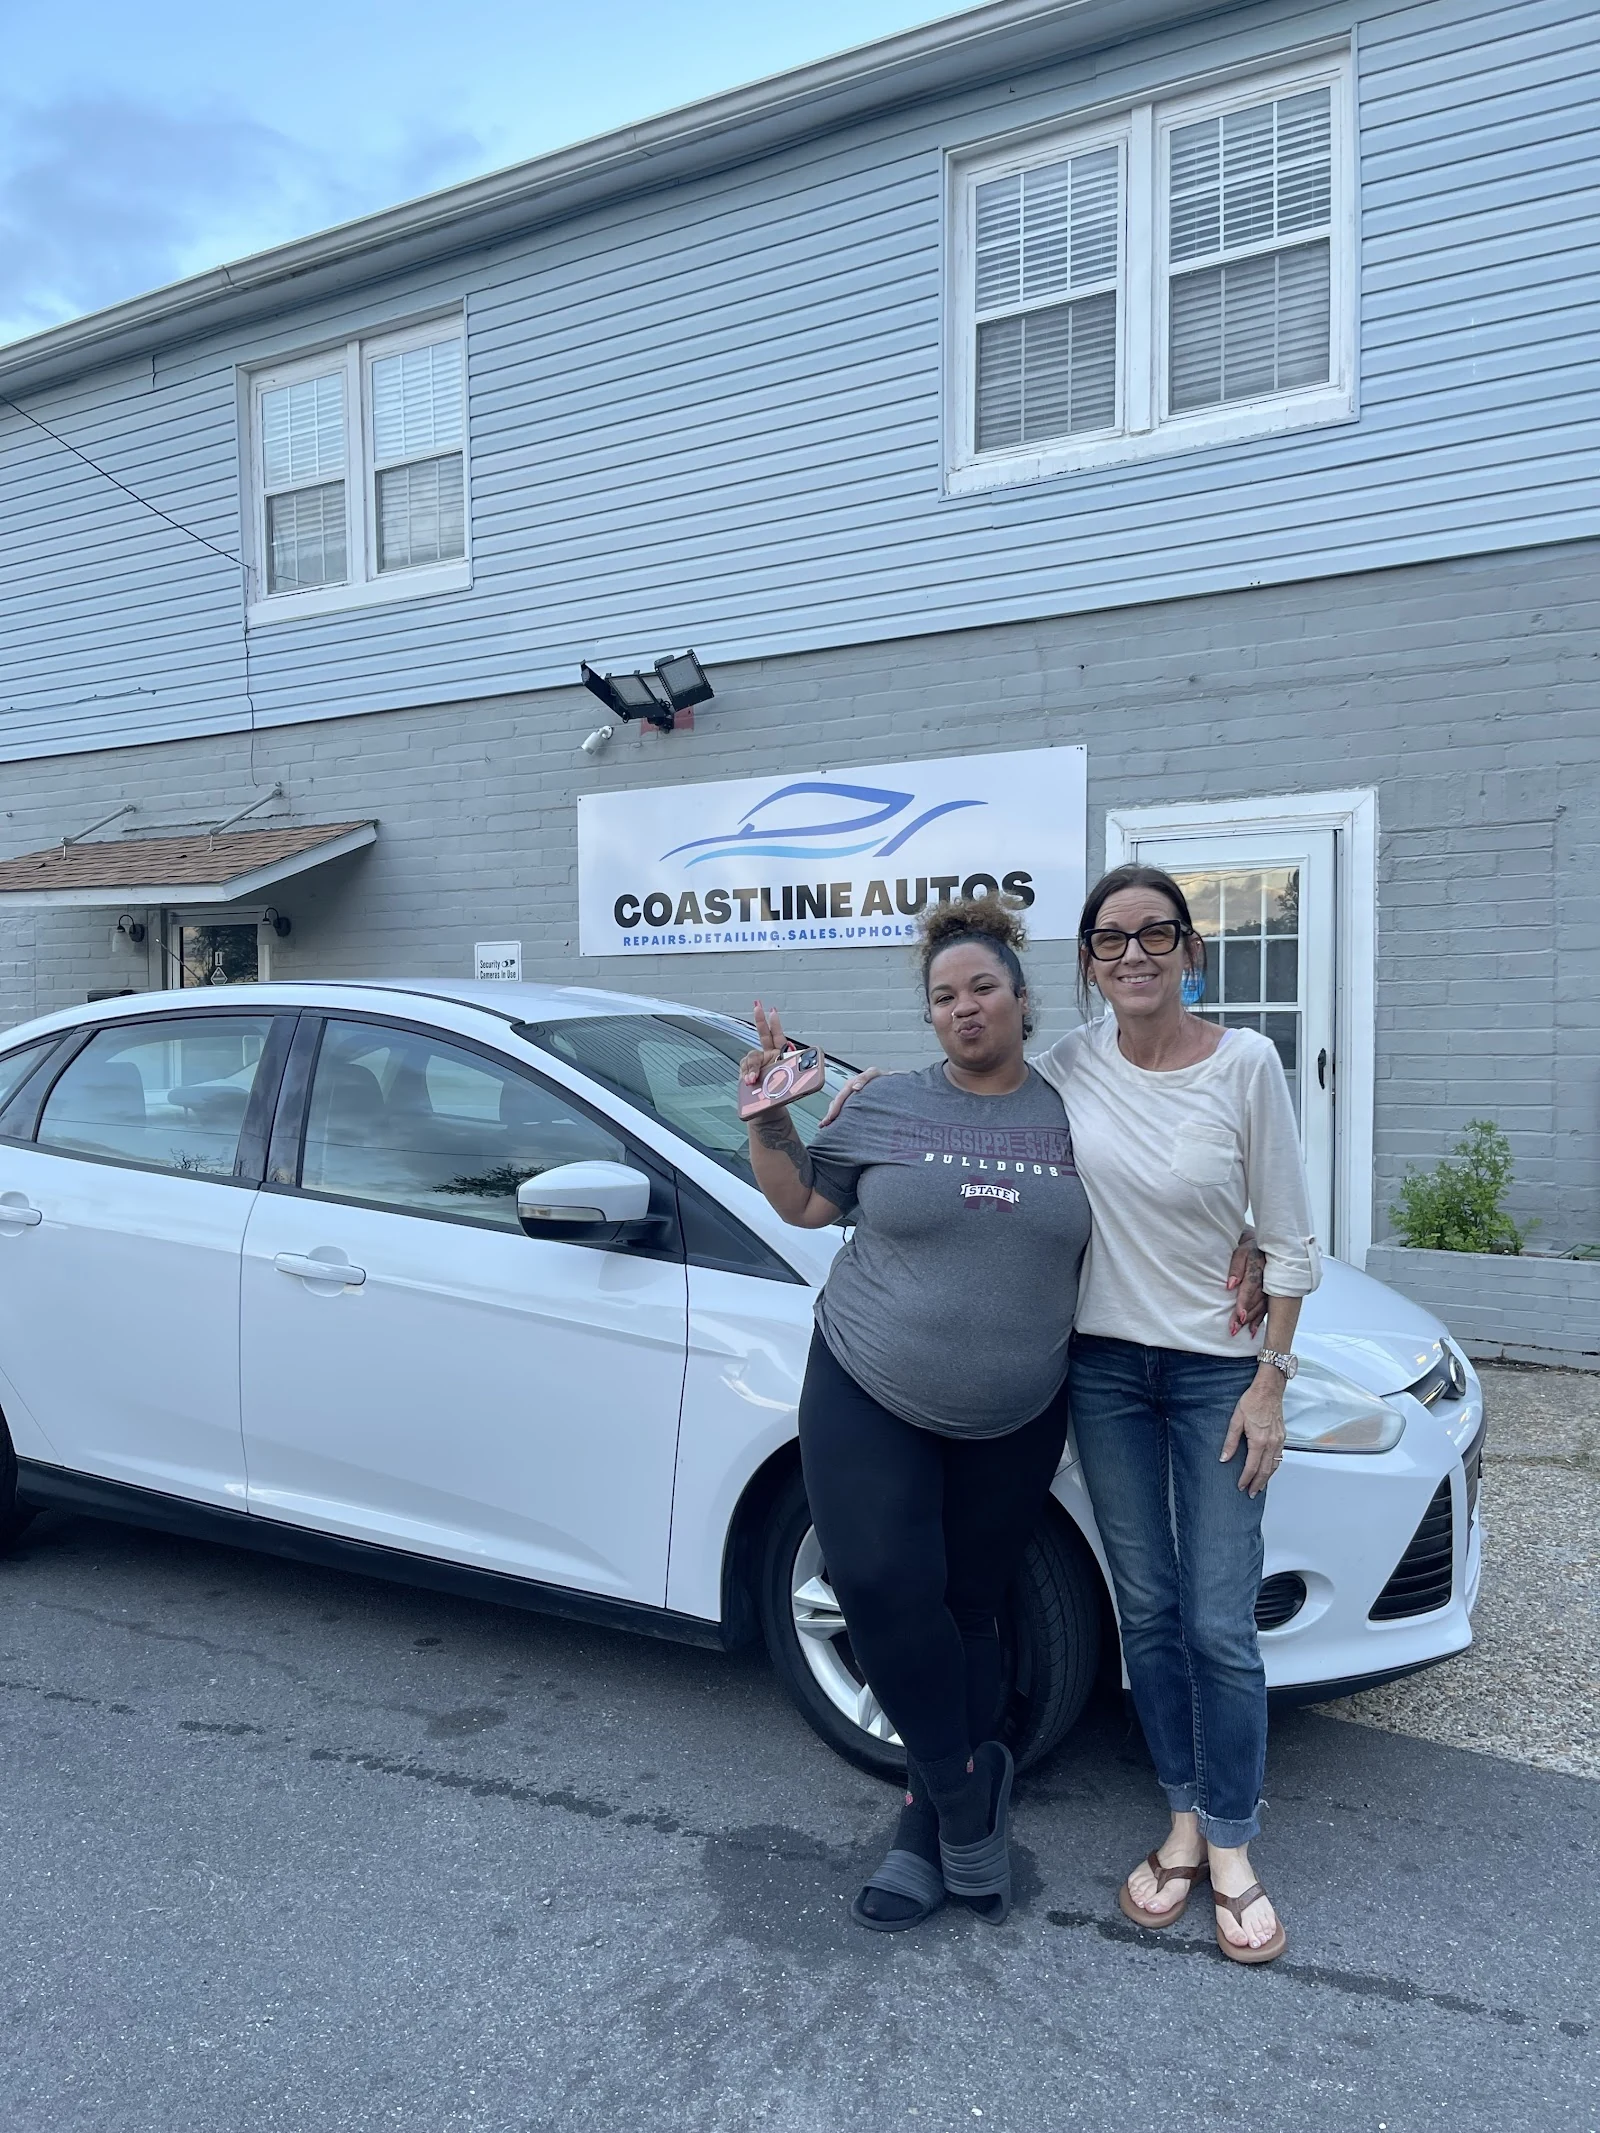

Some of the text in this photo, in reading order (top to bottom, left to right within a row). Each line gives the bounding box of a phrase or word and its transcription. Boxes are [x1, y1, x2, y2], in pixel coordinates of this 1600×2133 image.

[614, 870, 1035, 929] COASTLINE AUTOS
[623, 924, 914, 947] REPAIRS.DETAILING.SALES.UPHOLS
[480, 960, 500, 970] Security
[480, 970, 500, 980] Cameras
[507, 970, 516, 979] Use
[924, 1152, 1059, 1177] BULLDOGS
[969, 1186, 1011, 1200] STATE
